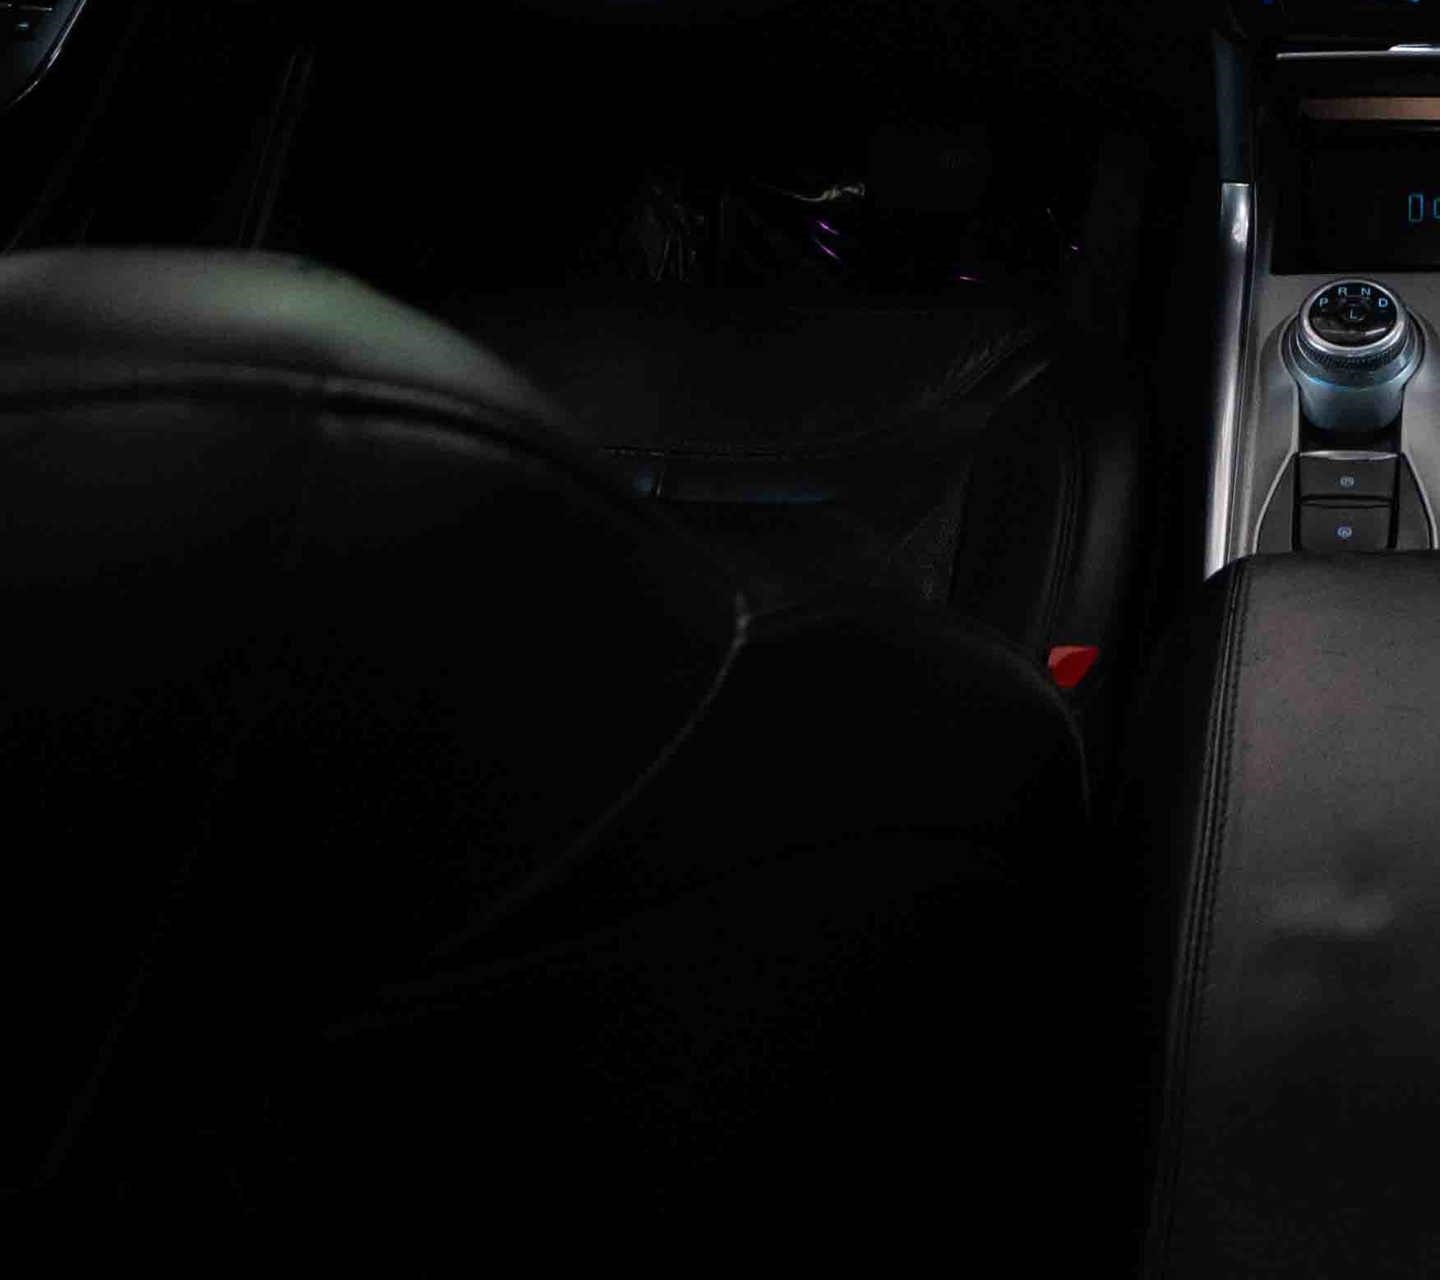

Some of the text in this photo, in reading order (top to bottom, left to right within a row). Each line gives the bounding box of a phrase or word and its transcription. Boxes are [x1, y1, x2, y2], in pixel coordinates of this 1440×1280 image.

[1337, 286, 1371, 298] R N
[1318, 297, 1389, 319] P L D
